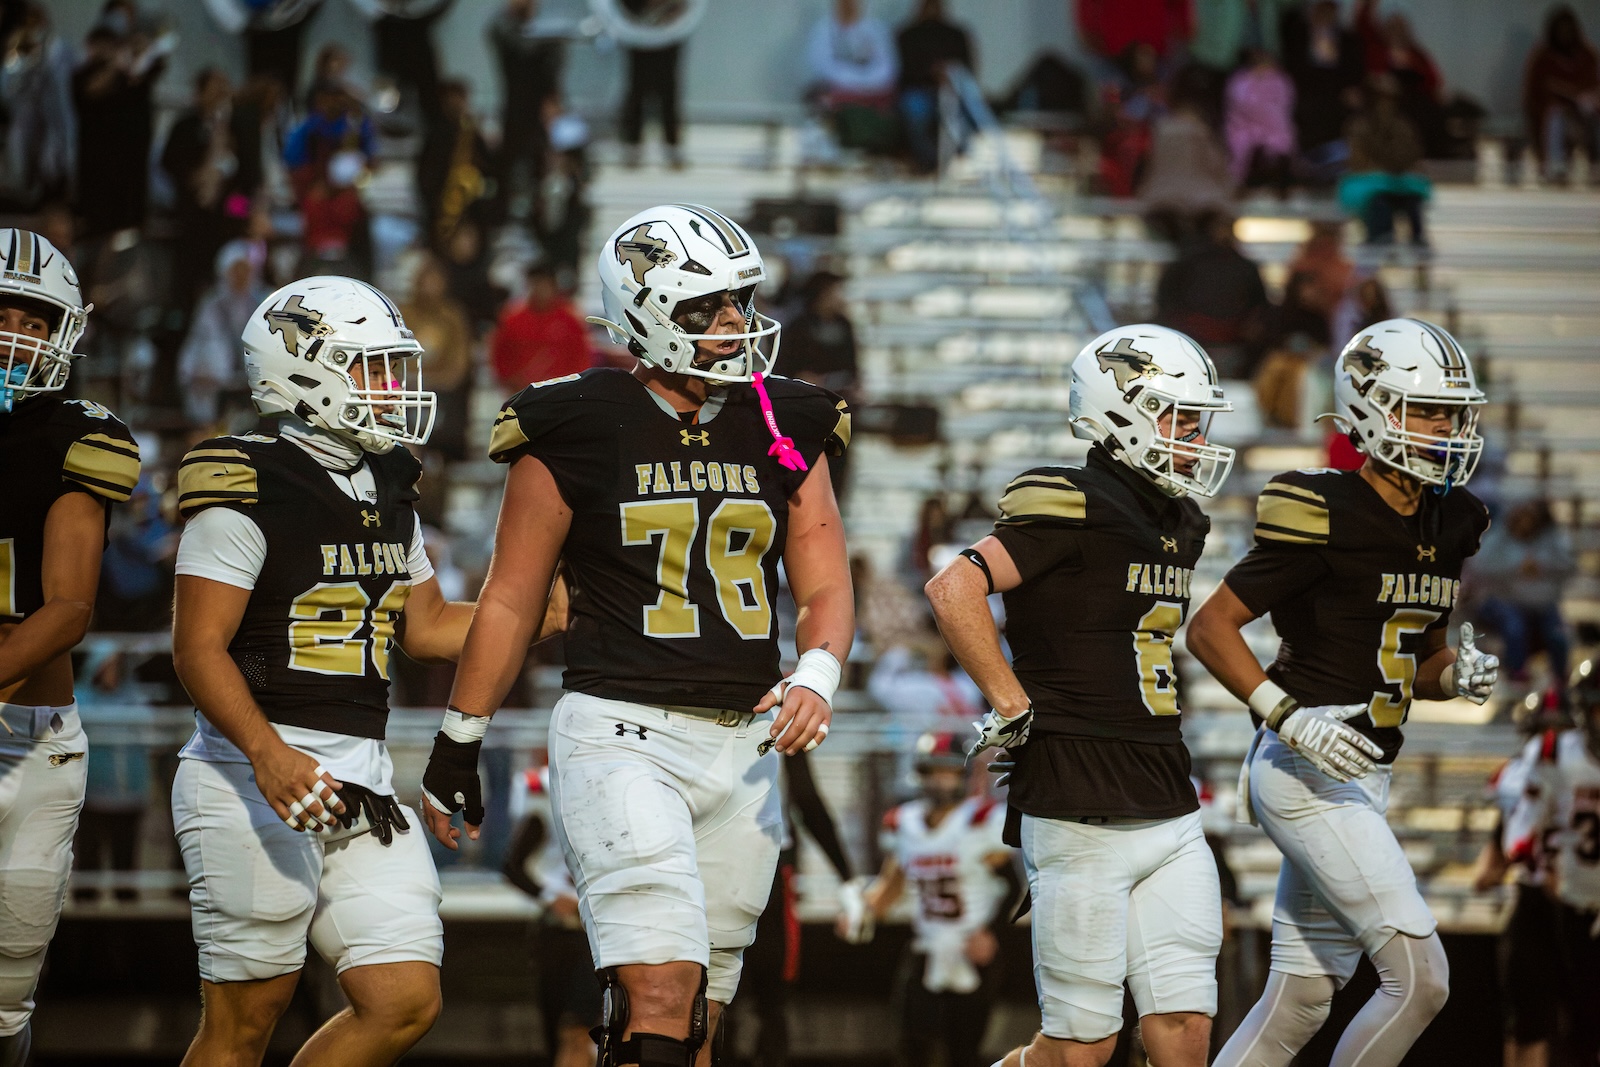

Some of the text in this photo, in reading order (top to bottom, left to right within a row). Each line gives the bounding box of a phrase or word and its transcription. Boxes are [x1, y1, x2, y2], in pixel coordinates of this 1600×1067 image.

[765, 410, 783, 438] NXTRND
[635, 461, 761, 495] FALCONS
[619, 497, 777, 640] 78
[1126, 563, 1194, 598] FALCON
[1367, 608, 1442, 728] 5
